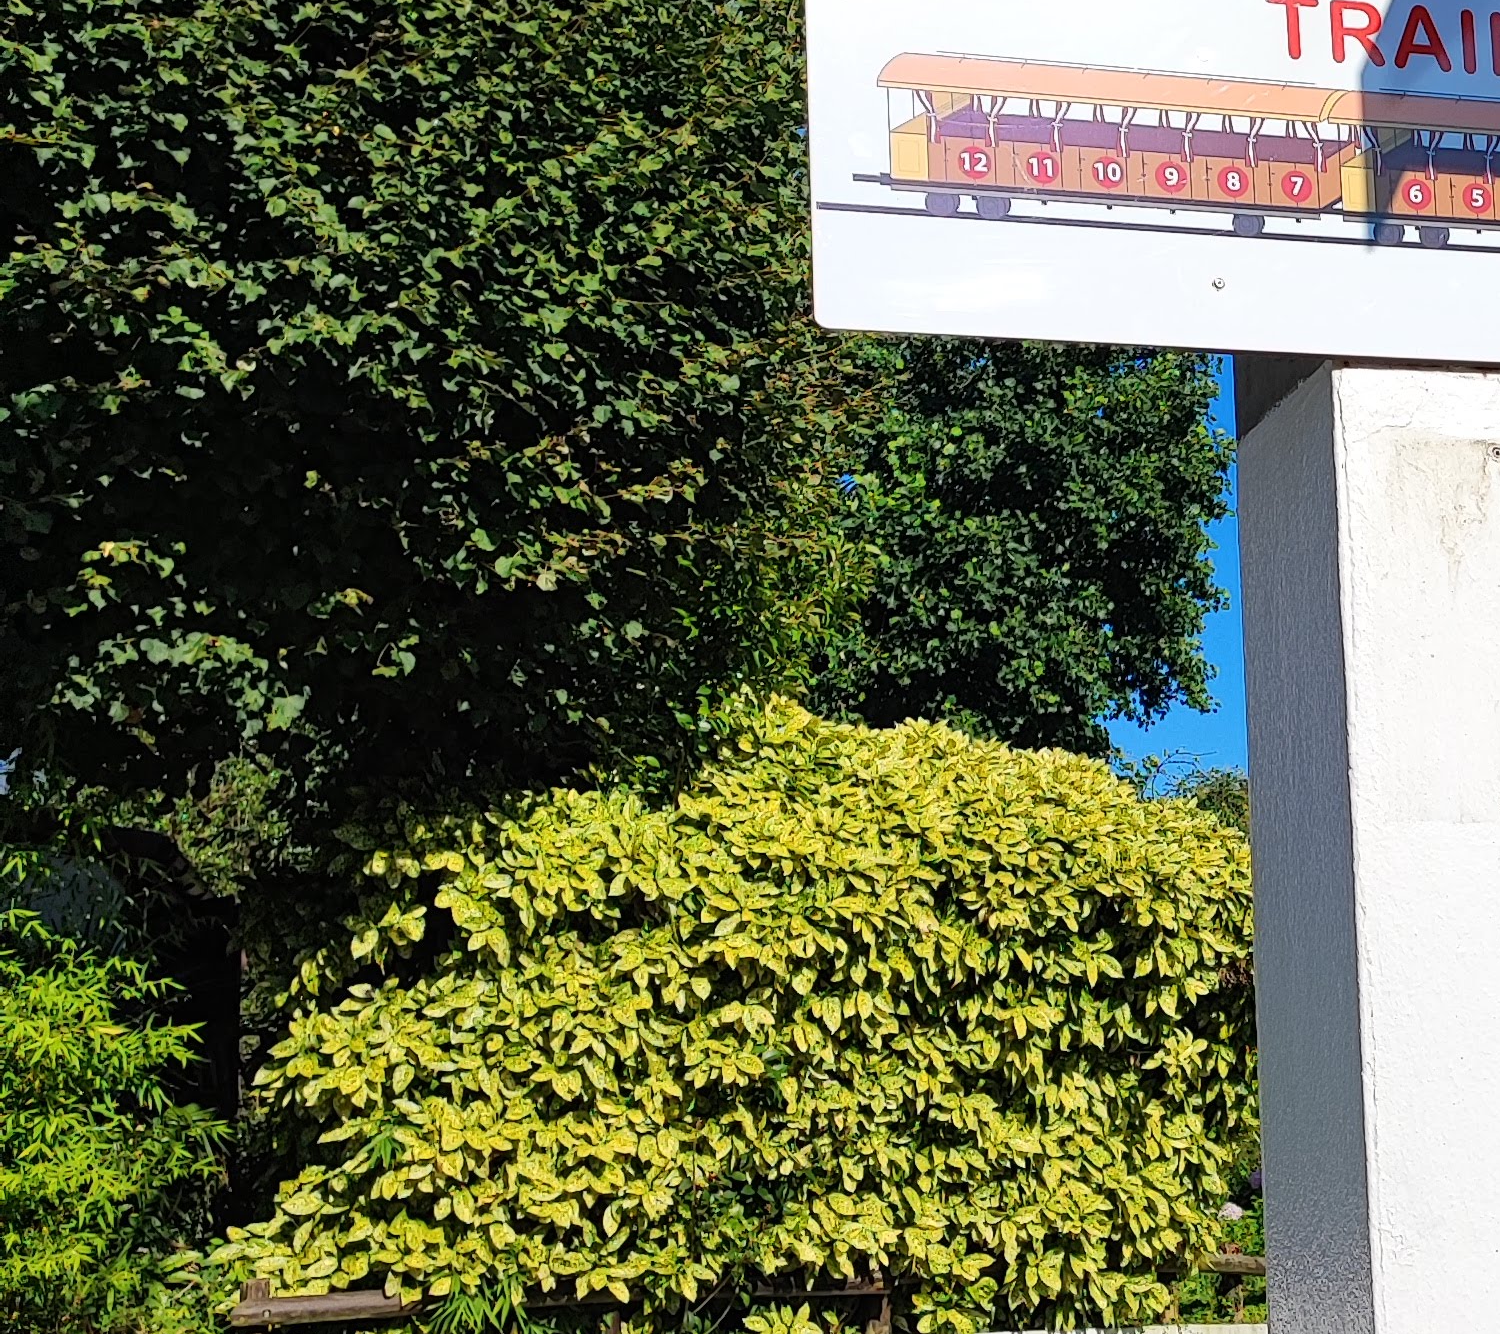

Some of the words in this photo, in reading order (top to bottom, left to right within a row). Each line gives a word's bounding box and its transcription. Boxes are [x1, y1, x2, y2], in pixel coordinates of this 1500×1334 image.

[959, 152, 989, 173] 12
[1028, 156, 1055, 177] 11
[1093, 162, 1122, 183] 10
[1164, 166, 1179, 186] 9
[1226, 171, 1241, 191] 8
[1290, 176, 1304, 196] 7
[1408, 185, 1423, 204] 6
[1470, 189, 1484, 208] 5
